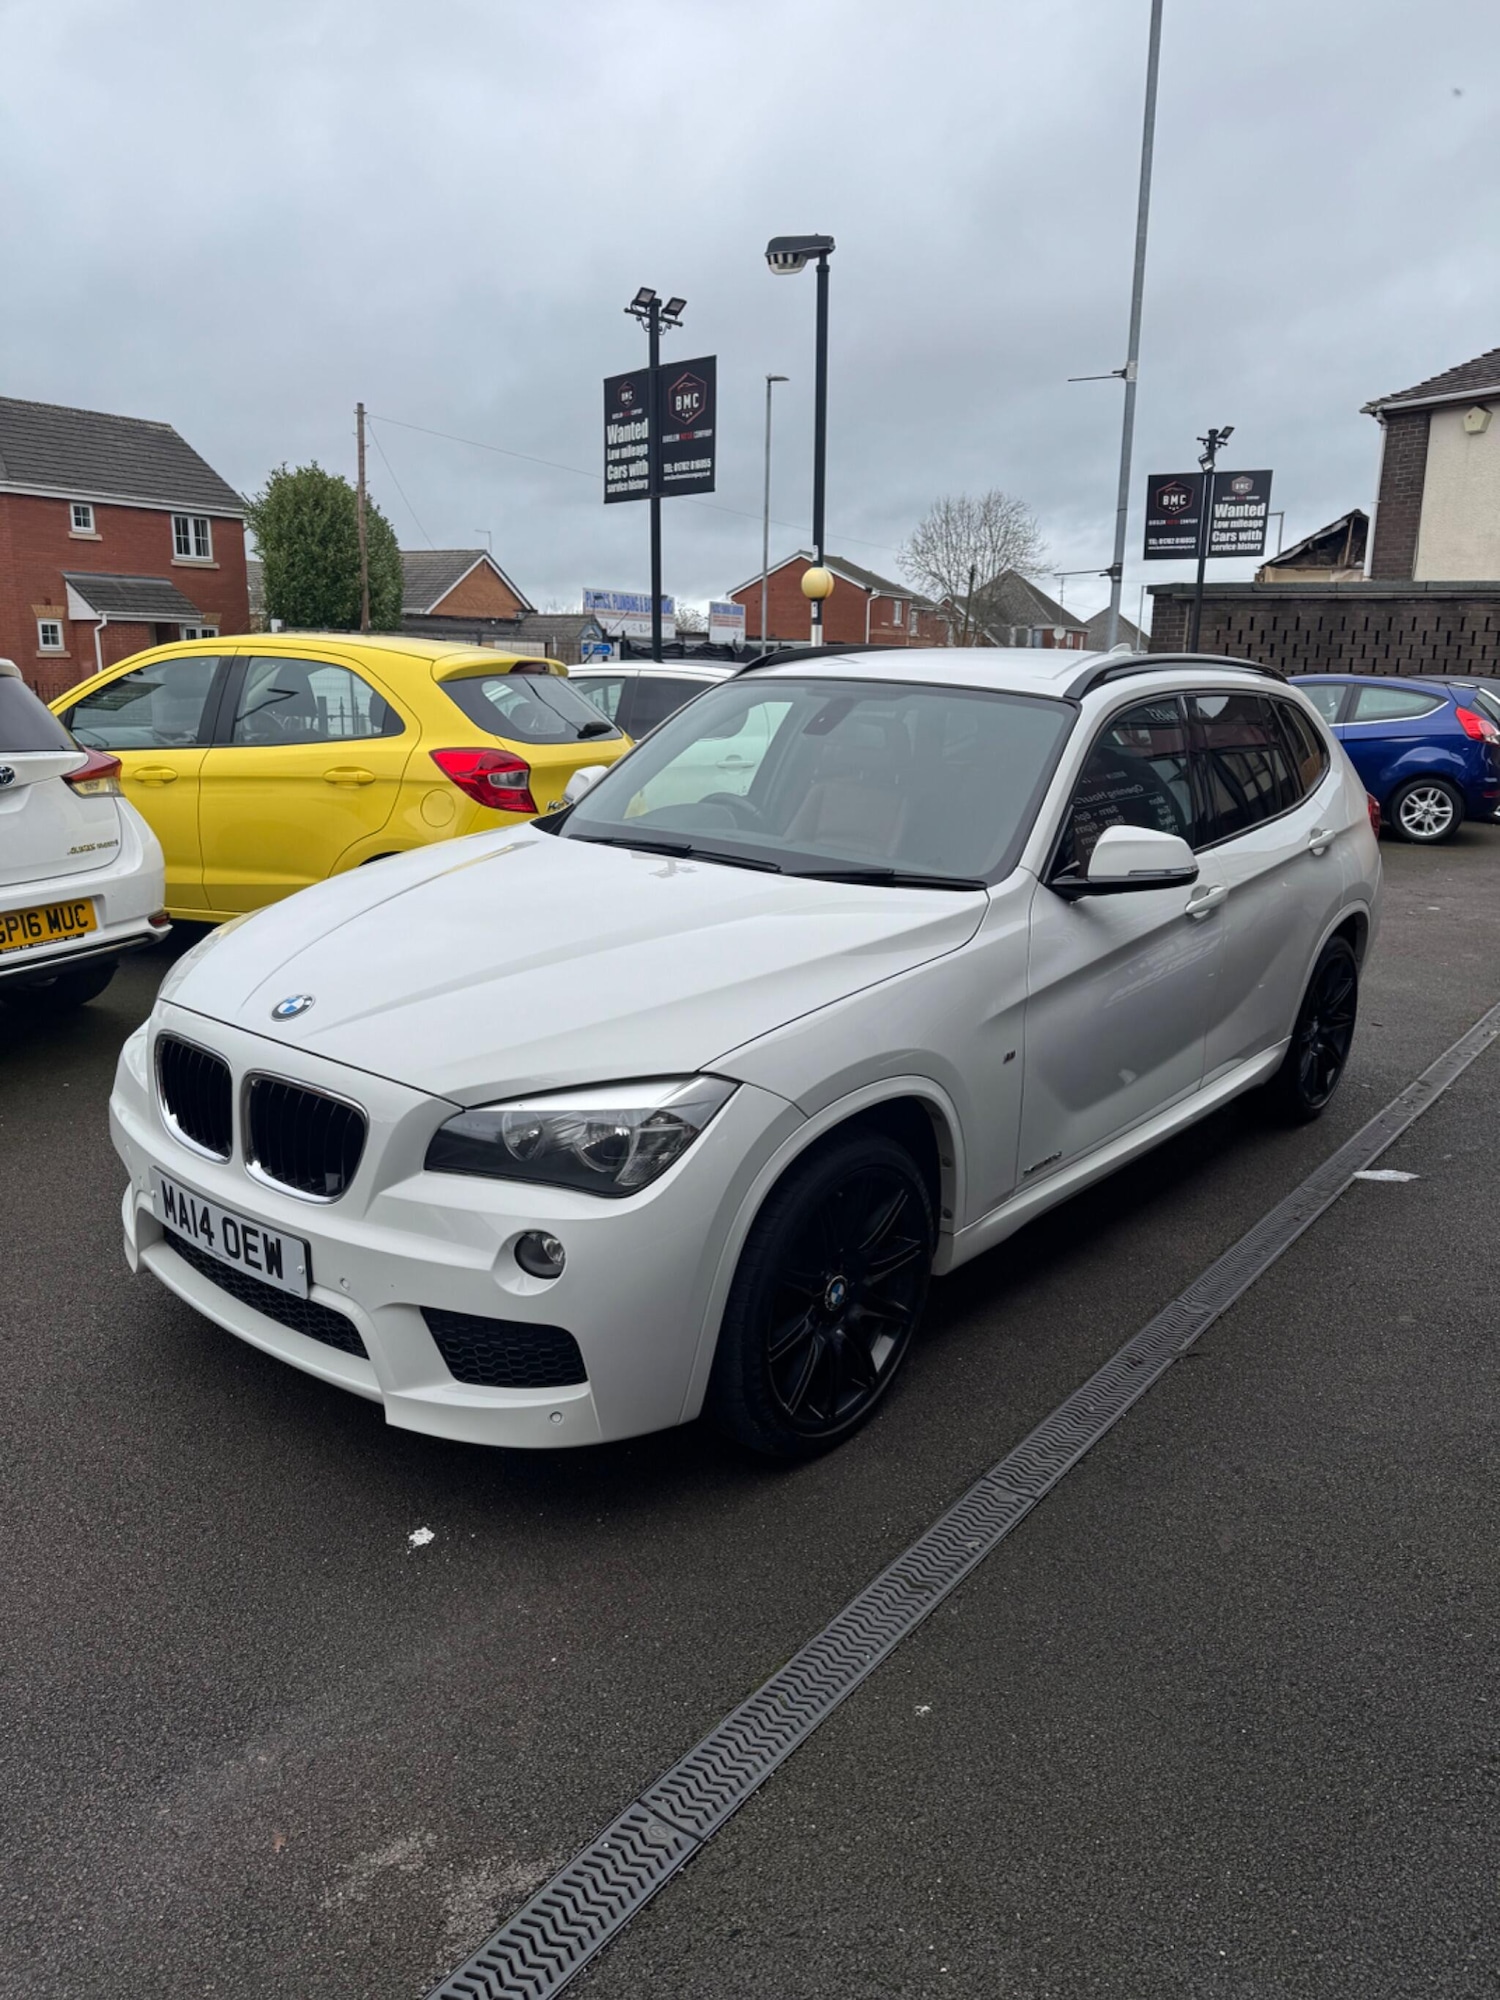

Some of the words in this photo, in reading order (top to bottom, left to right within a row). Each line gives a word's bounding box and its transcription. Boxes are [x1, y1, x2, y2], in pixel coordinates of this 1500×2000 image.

[675, 393, 699, 411] BMC
[607, 418, 649, 445] Wanted
[607, 448, 620, 461] Low
[621, 444, 648, 459] mileage
[607, 464, 628, 480] Cars
[628, 459, 649, 477] with
[607, 482, 628, 493] service
[628, 479, 649, 491] history
[1163, 494, 1187, 506] BMC
[1215, 503, 1266, 518] Wanted
[1213, 520, 1230, 529] Low
[1230, 519, 1264, 529] mileage
[1212, 530, 1237, 542] Cars
[1238, 529, 1263, 541] with
[1211, 543, 1237, 551] service
[1237, 542, 1262, 550] history
[45, 904, 89, 934] MUC
[161, 1179, 215, 1247] MA14
[222, 1216, 283, 1280] OEW
